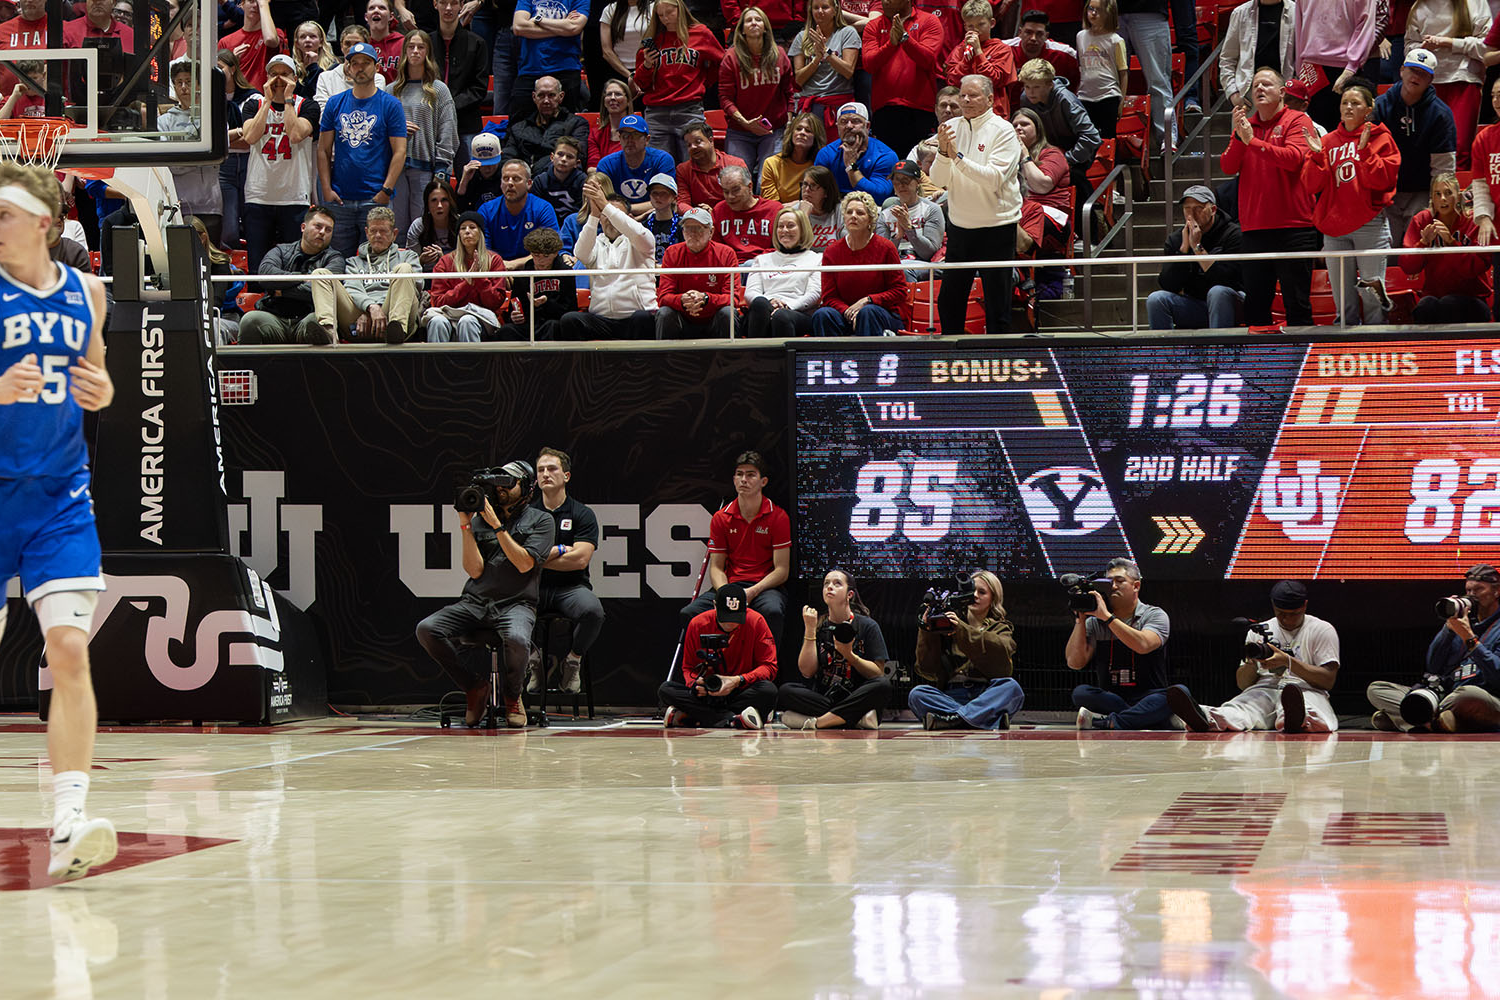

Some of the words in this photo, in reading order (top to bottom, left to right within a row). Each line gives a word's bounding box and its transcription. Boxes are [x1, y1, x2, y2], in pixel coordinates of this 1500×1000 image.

[739, 67, 781, 86] UTAH
[261, 137, 294, 161] 44
[719, 217, 772, 237] UTAH
[200, 263, 213, 348] FIRST
[2, 311, 87, 351] BYU
[140, 306, 165, 397] FIRST
[807, 360, 860, 385] FLS
[876, 354, 900, 387] 8
[931, 358, 1049, 384] BONUS+
[1317, 353, 1420, 378] BONUS
[876, 402, 922, 421] TOL
[1128, 373, 1244, 429] 1:26
[1444, 392, 1491, 413] TOL
[206, 354, 228, 497] AMERICA
[140, 403, 164, 546] AMERICA
[1124, 456, 1176, 482] 2ND
[1180, 456, 1241, 482] HALF
[849, 460, 958, 542] 85
[1404, 458, 1500, 545] 82
[389, 503, 713, 599] UES
